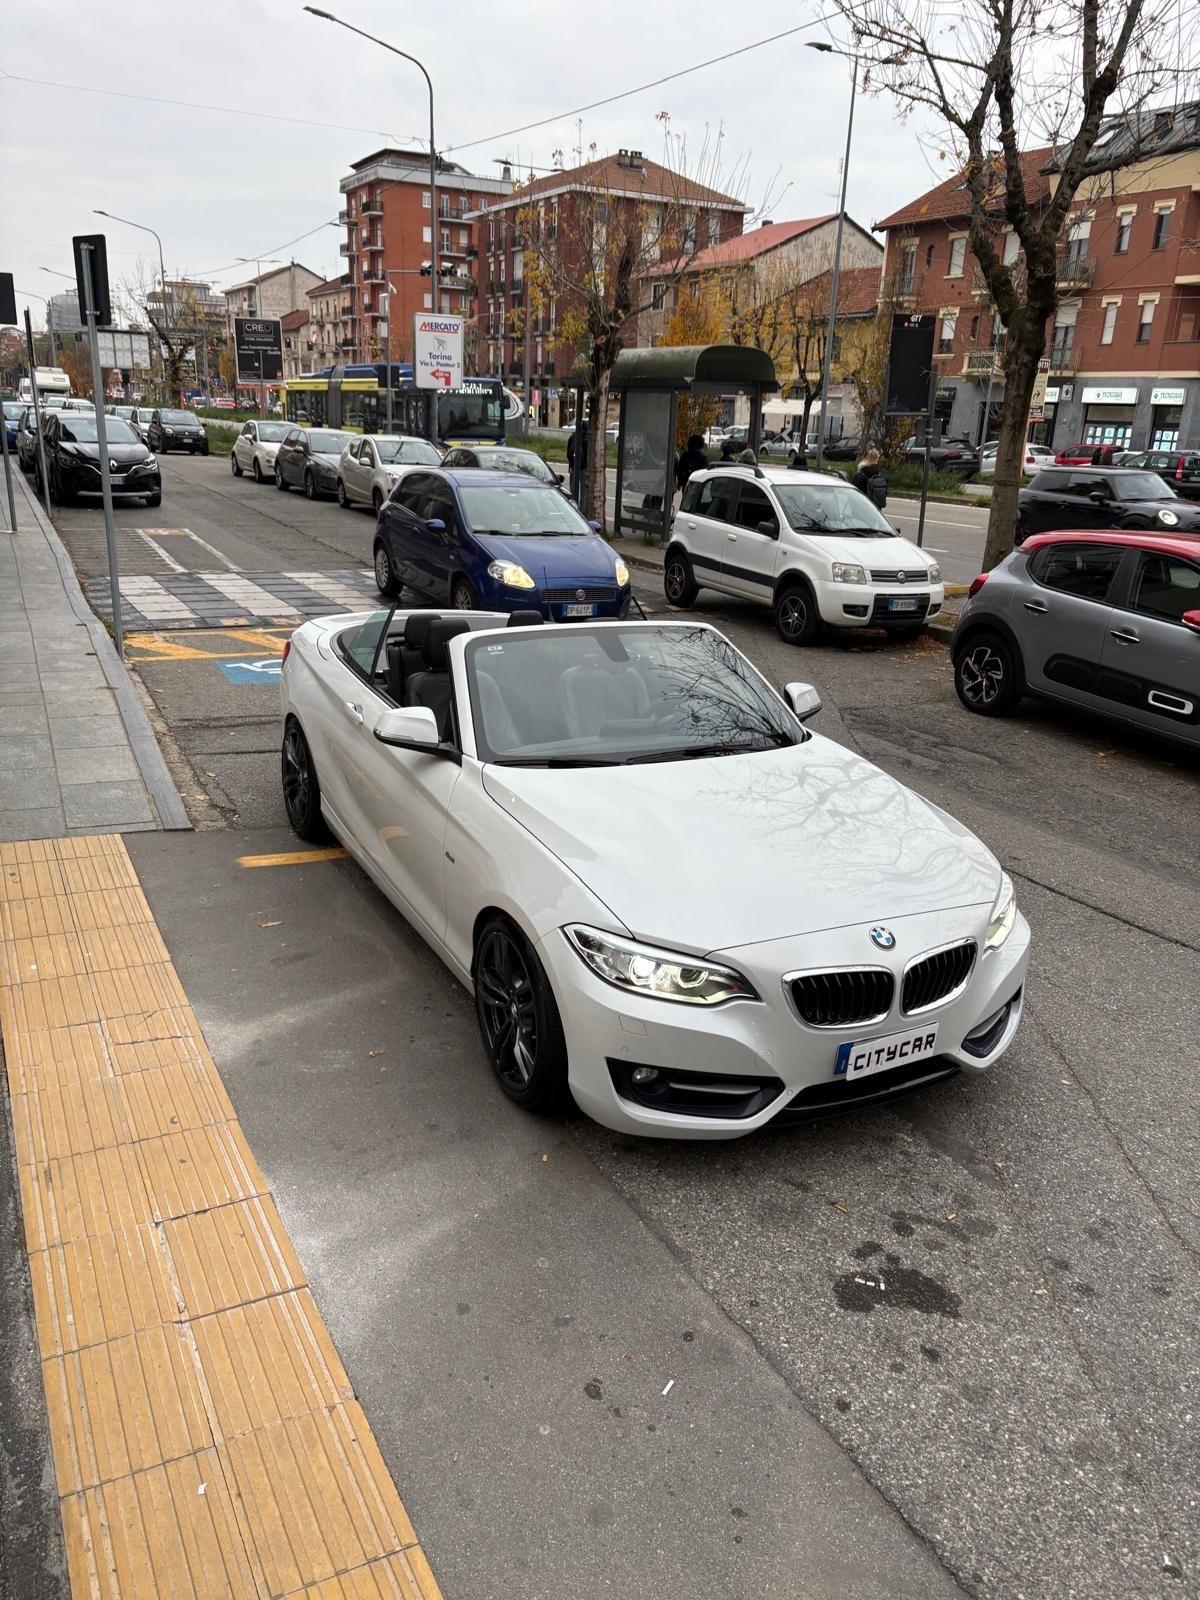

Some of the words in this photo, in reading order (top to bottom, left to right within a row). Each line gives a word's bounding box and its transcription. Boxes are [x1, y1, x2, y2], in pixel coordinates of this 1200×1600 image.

[245, 323, 272, 332] CREO
[428, 352, 452, 361] Torino
[853, 1032, 936, 1071] CITYCAR
